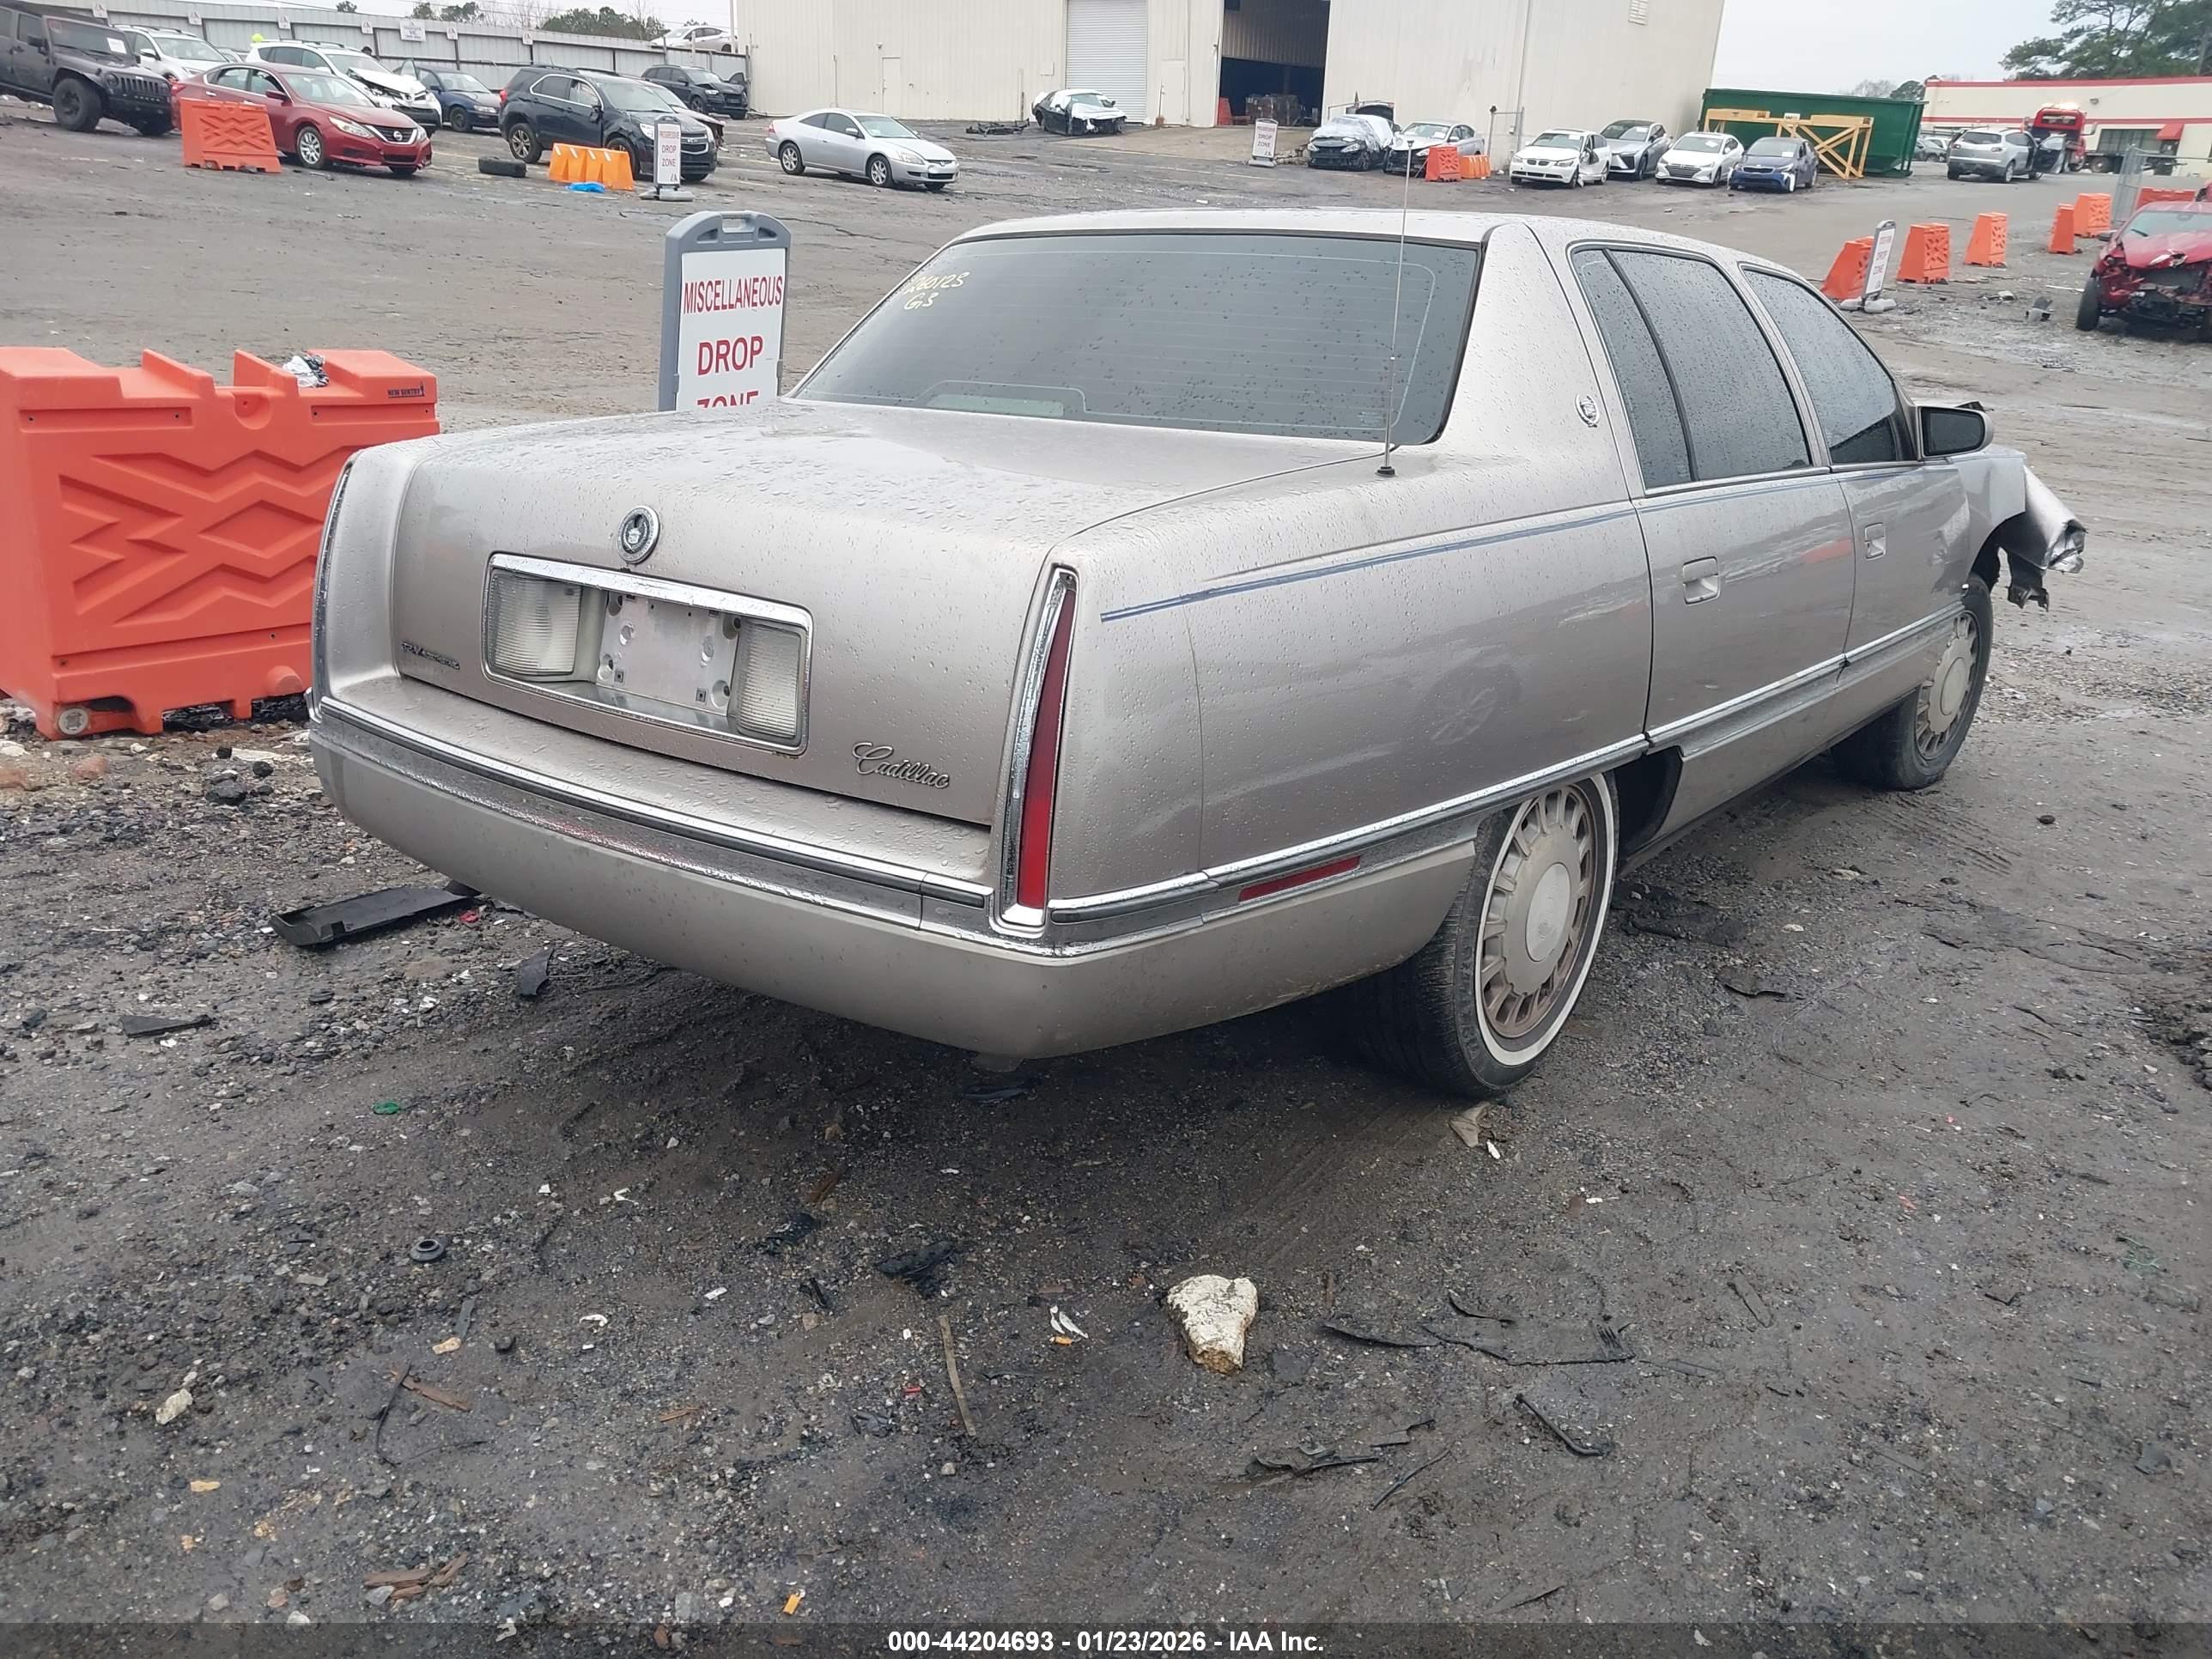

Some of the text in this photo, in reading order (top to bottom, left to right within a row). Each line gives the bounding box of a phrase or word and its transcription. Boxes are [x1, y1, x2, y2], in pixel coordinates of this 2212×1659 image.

[661, 144, 677, 154] DROP
[661, 158, 676, 167] ZONE
[684, 275, 783, 314] MISCELLANEOUS
[697, 335, 763, 376] DROP
[852, 742, 950, 789] Cadillac
